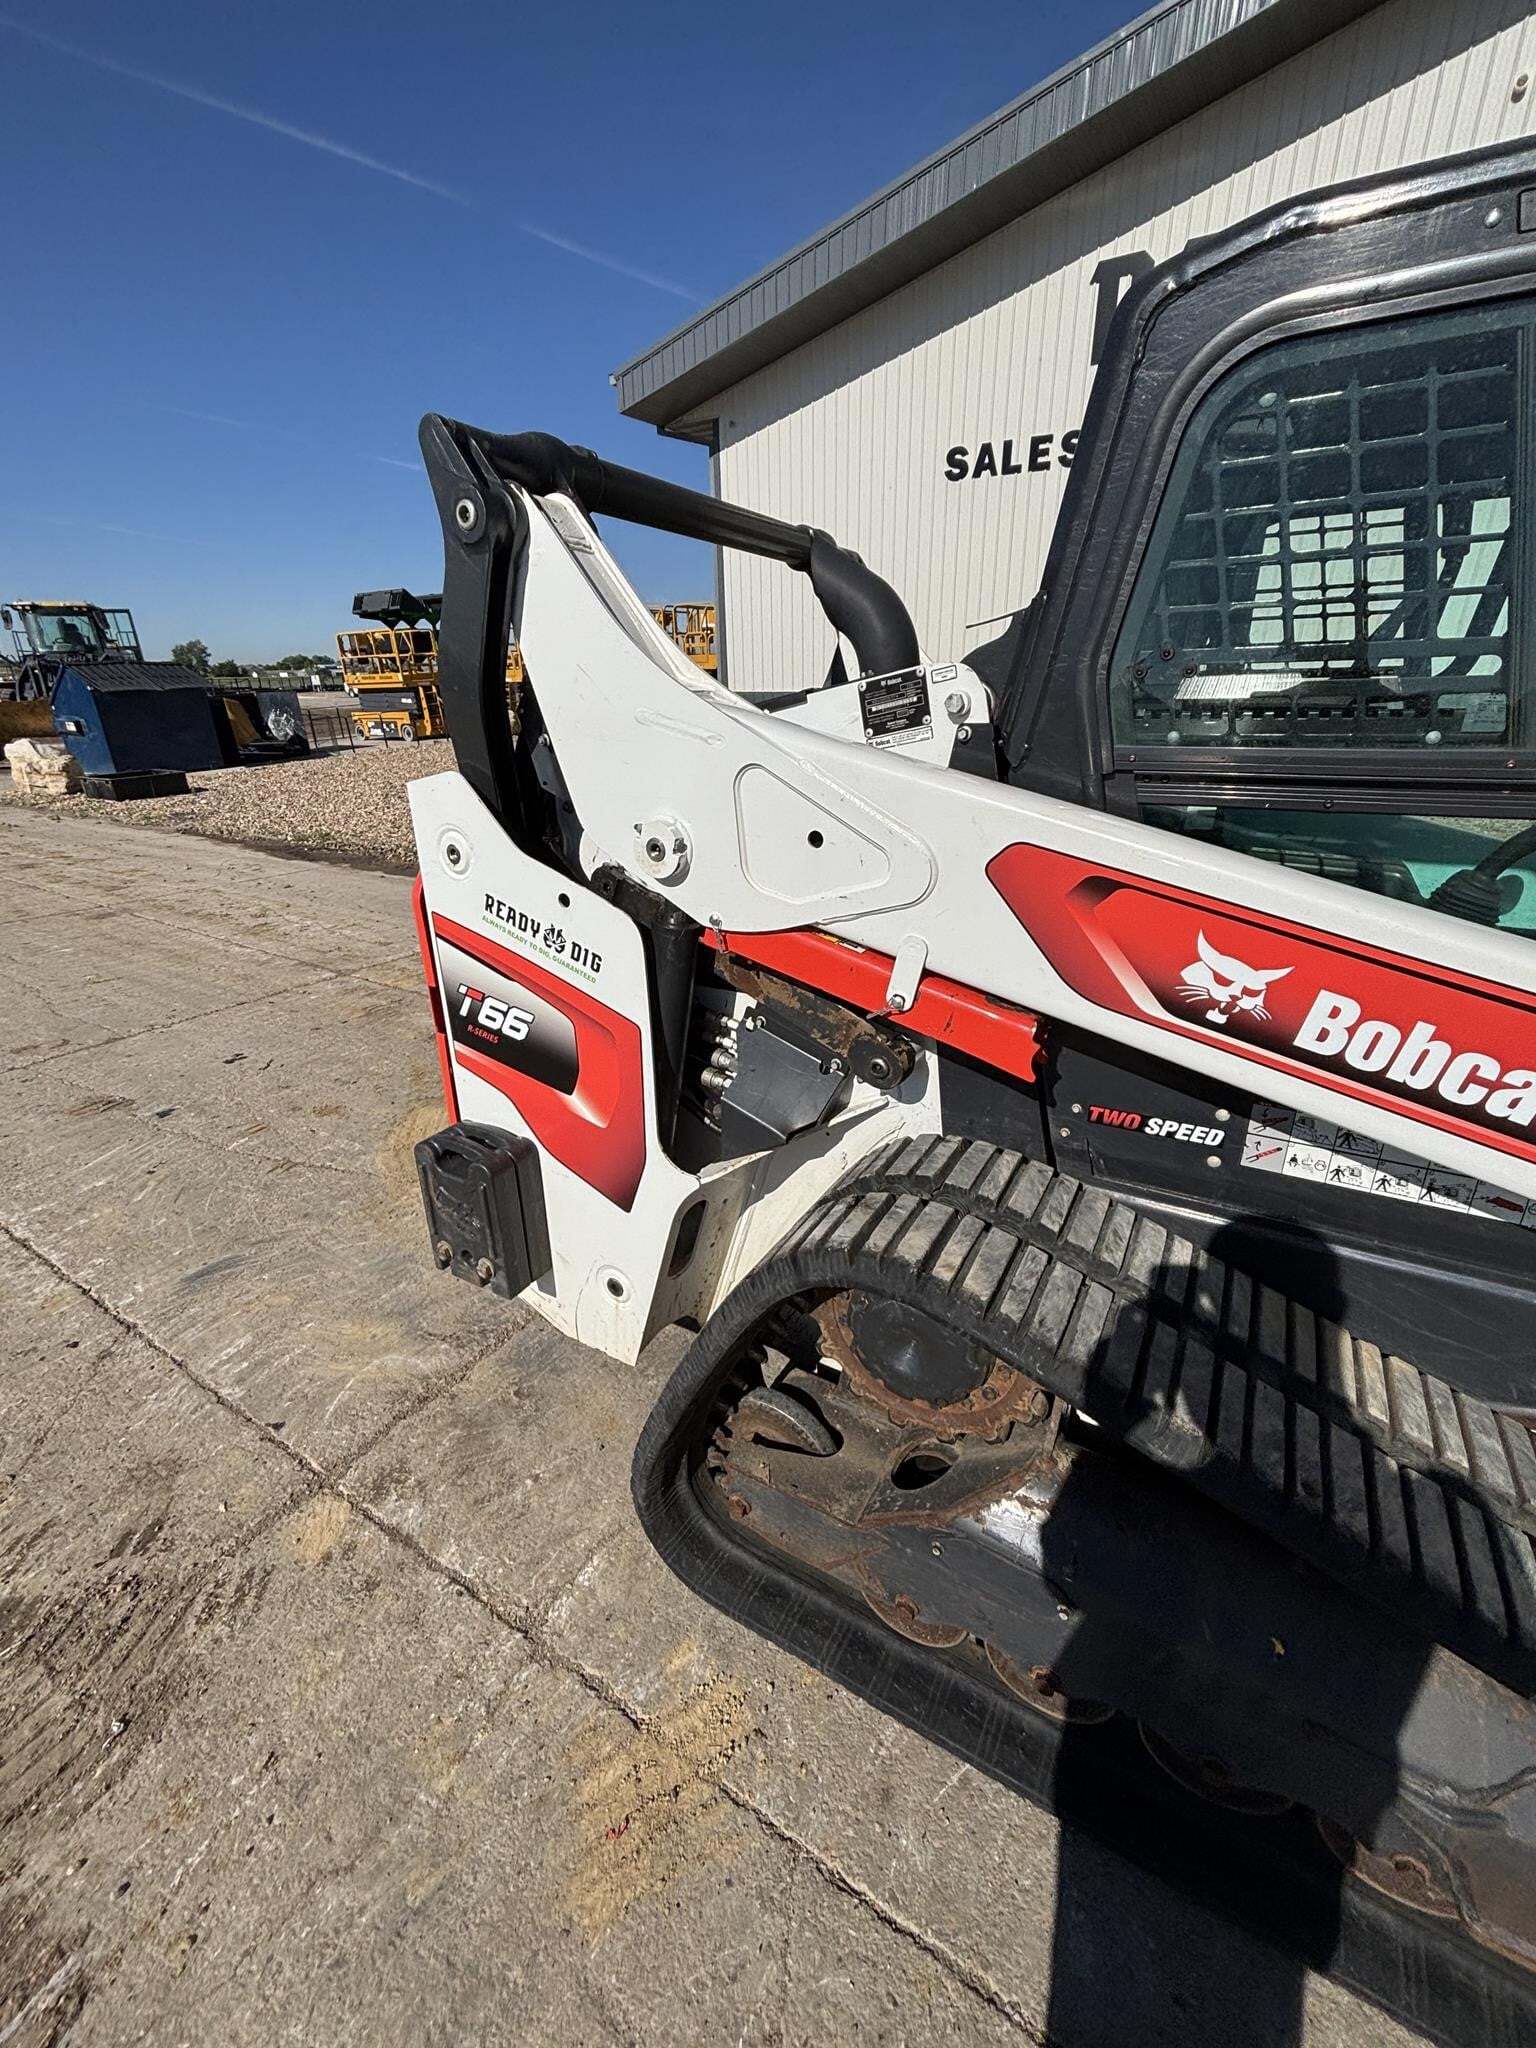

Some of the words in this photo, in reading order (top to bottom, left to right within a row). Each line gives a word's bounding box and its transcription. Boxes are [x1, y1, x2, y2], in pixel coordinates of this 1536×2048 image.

[944, 429, 1082, 482] SALES
[482, 915, 507, 933] ALWAYS
[507, 929, 529, 946] READY
[529, 941, 539, 952] TO
[552, 954, 597, 983] GUARANTEED
[485, 893, 541, 938] READY
[570, 941, 603, 973] DIG
[457, 983, 535, 1041] T66
[467, 1024, 500, 1044] R-SERIES
[1293, 989, 1536, 1127] Bobca
[1088, 1106, 1141, 1131] TWO
[1145, 1118, 1226, 1147] SPEED
